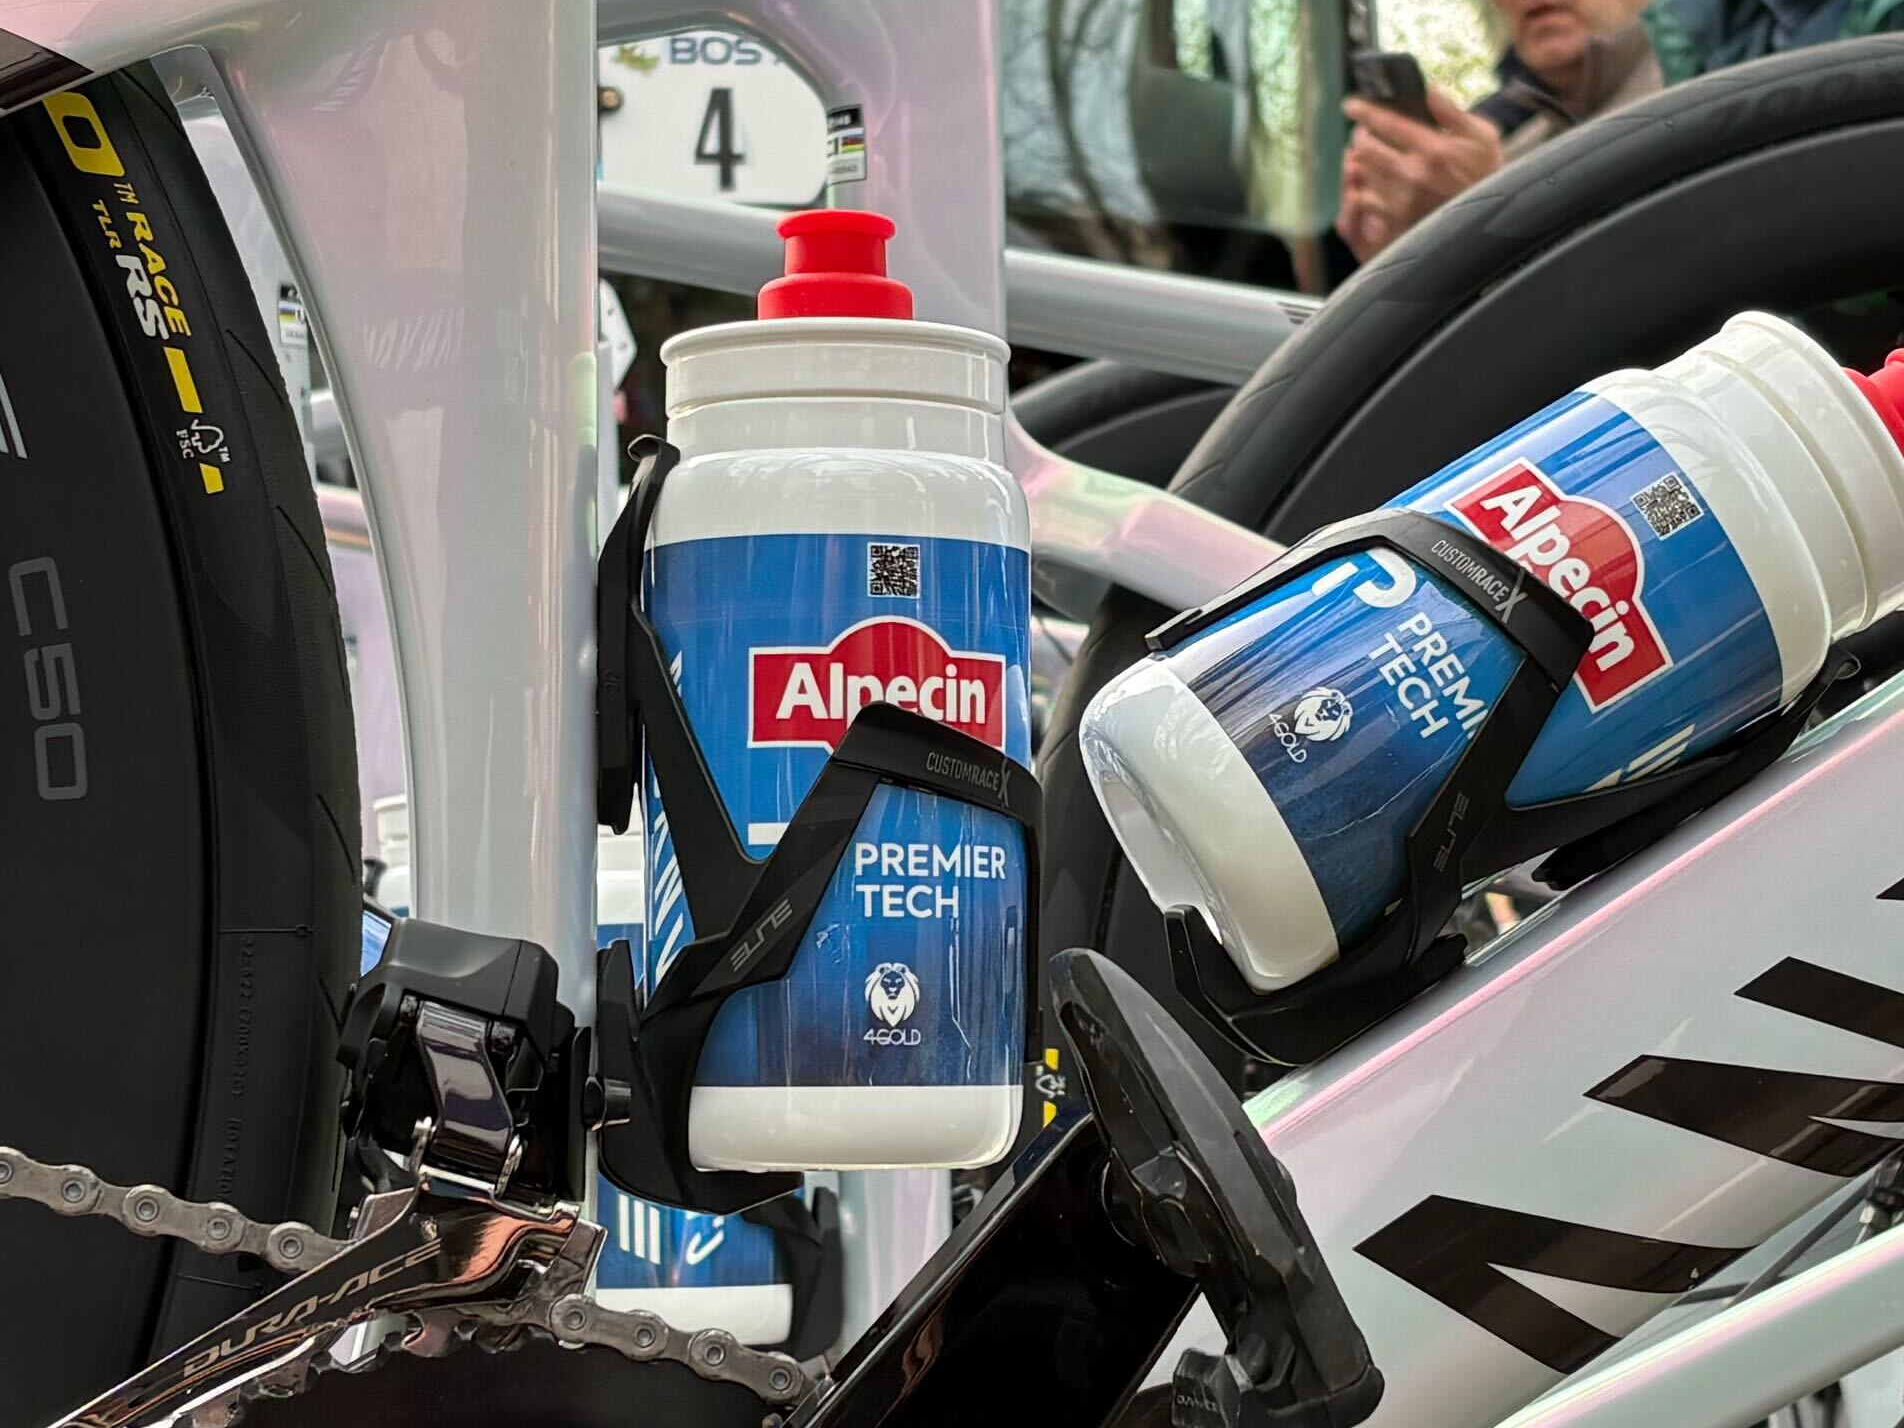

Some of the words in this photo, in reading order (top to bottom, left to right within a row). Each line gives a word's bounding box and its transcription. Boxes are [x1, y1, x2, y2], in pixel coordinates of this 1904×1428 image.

[694, 88, 746, 193] 4
[91, 203, 123, 250] TLR
[114, 254, 171, 341] RS
[125, 210, 192, 338] RACE
[1478, 483, 1637, 673] Alpecin
[7, 554, 89, 802] C50
[775, 662, 987, 726] Alpecin
[1368, 632, 1450, 740] TECH
[853, 842, 1007, 880] PREMIER
[854, 884, 960, 918] TECH
[183, 1236, 442, 1377] DURA-ACE
